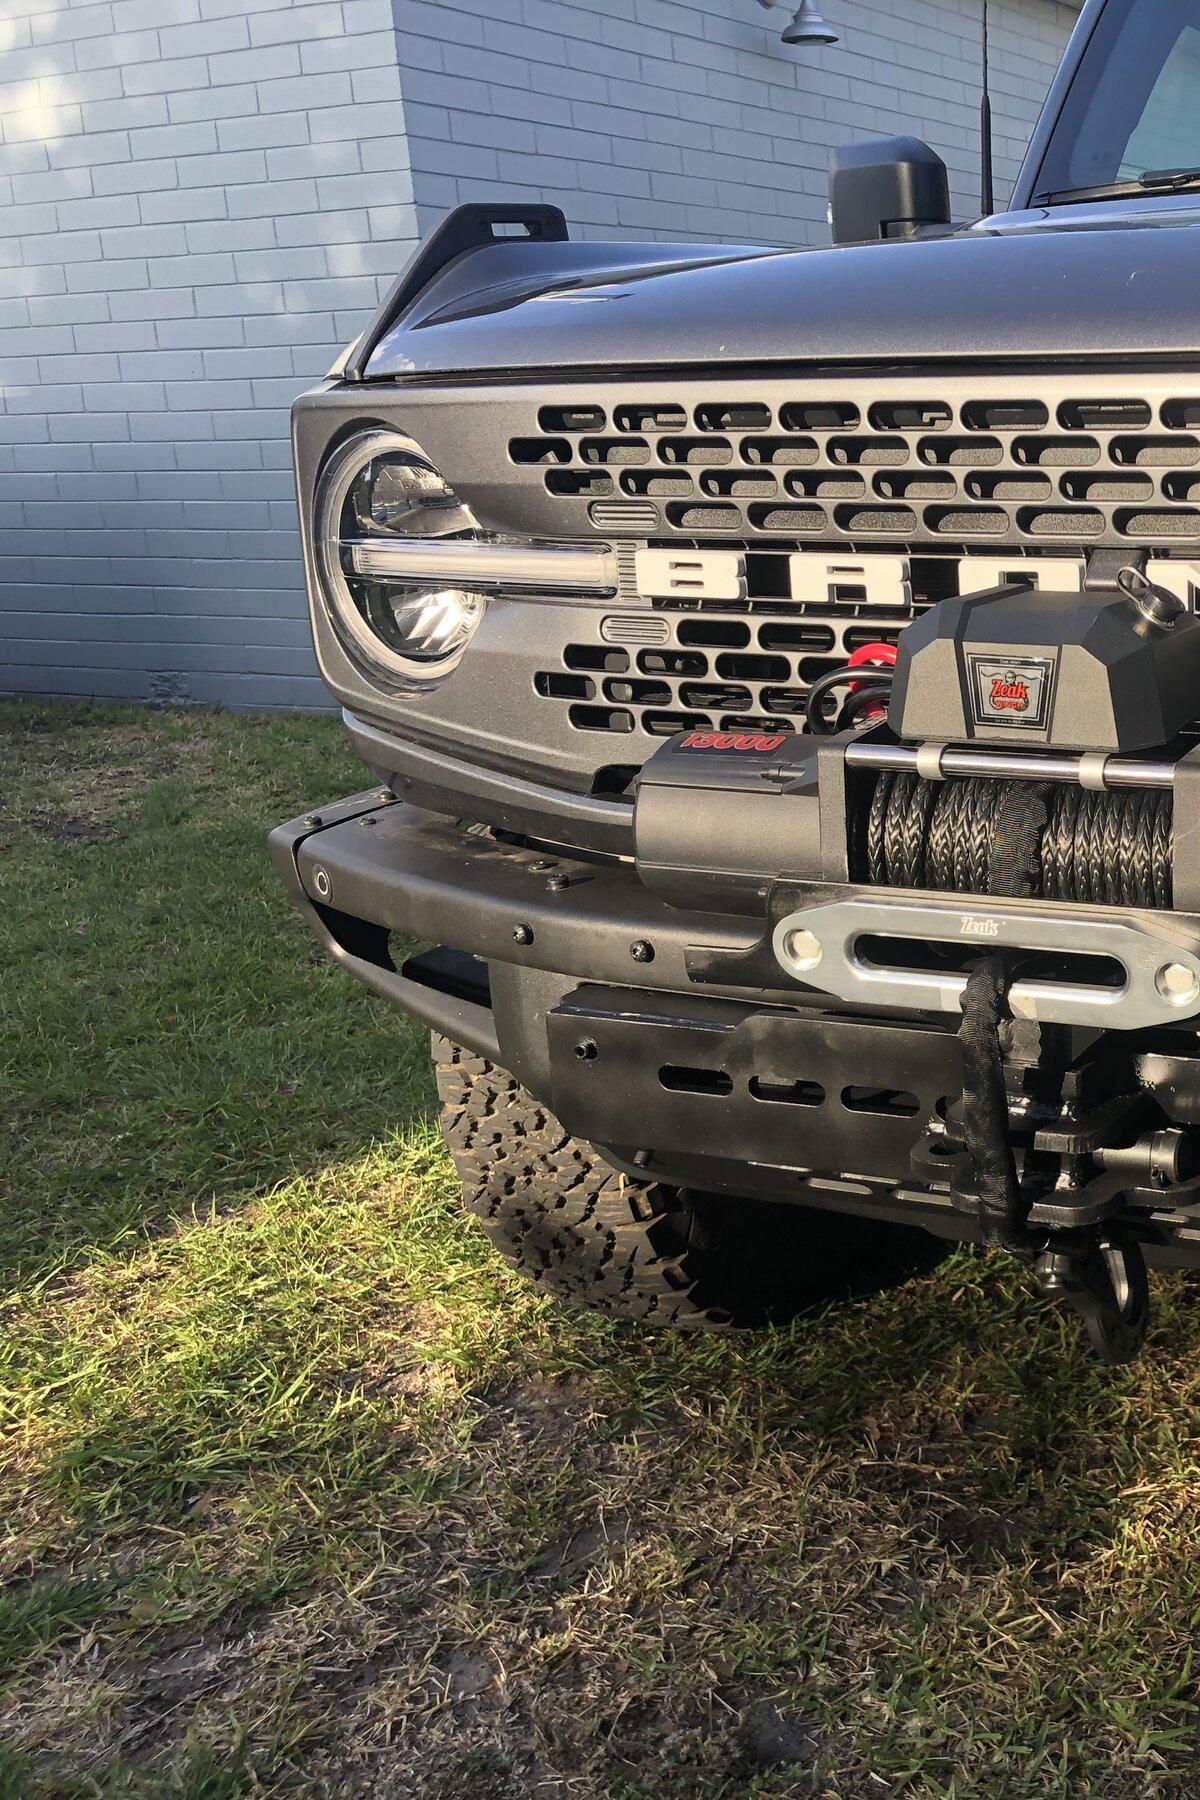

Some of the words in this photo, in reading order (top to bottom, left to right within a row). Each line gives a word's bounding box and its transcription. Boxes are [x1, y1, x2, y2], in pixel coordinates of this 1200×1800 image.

[991, 679, 1026, 699] Zeak
[680, 731, 786, 751] 13000
[960, 917, 999, 936] Zeak
